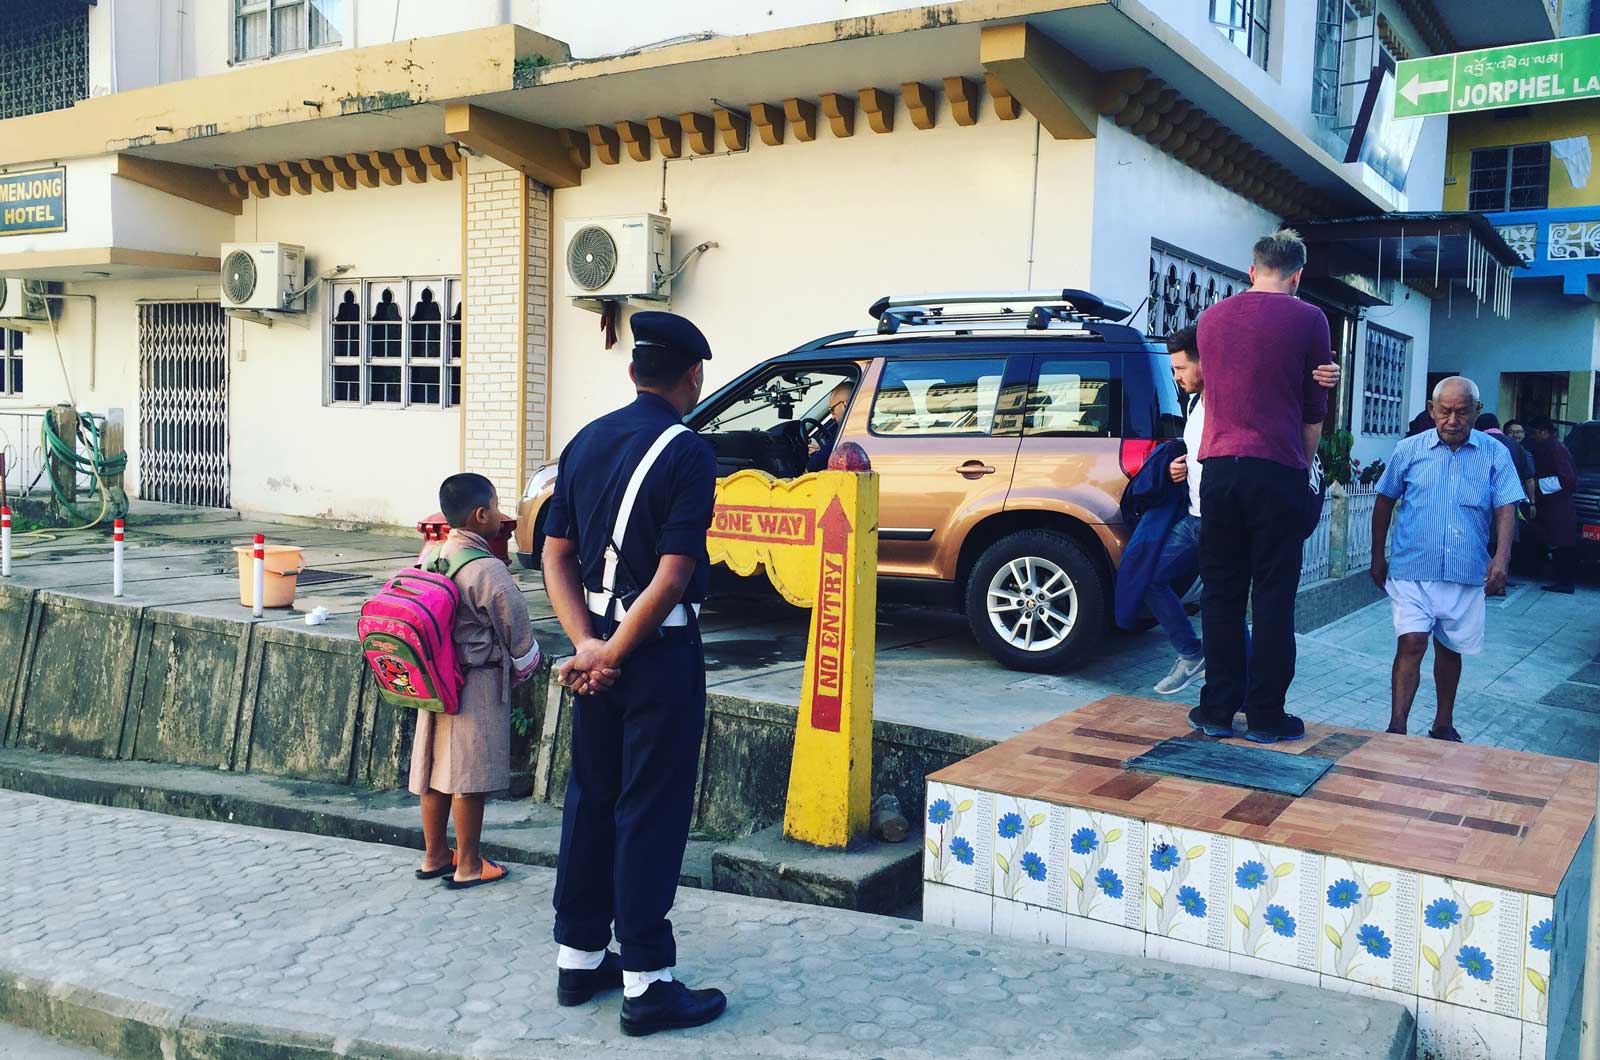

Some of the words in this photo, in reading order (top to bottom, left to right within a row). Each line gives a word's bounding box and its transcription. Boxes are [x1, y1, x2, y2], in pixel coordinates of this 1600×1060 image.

[1457, 74, 1565, 107] JORPHEL
[1573, 76, 1600, 93] LA
[0, 178, 62, 202] MENJONG
[4, 204, 55, 225] HOTEL
[715, 511, 752, 532] ONE
[757, 514, 803, 536] WAY
[821, 559, 843, 652] ENTRY
[820, 658, 839, 690] NO
